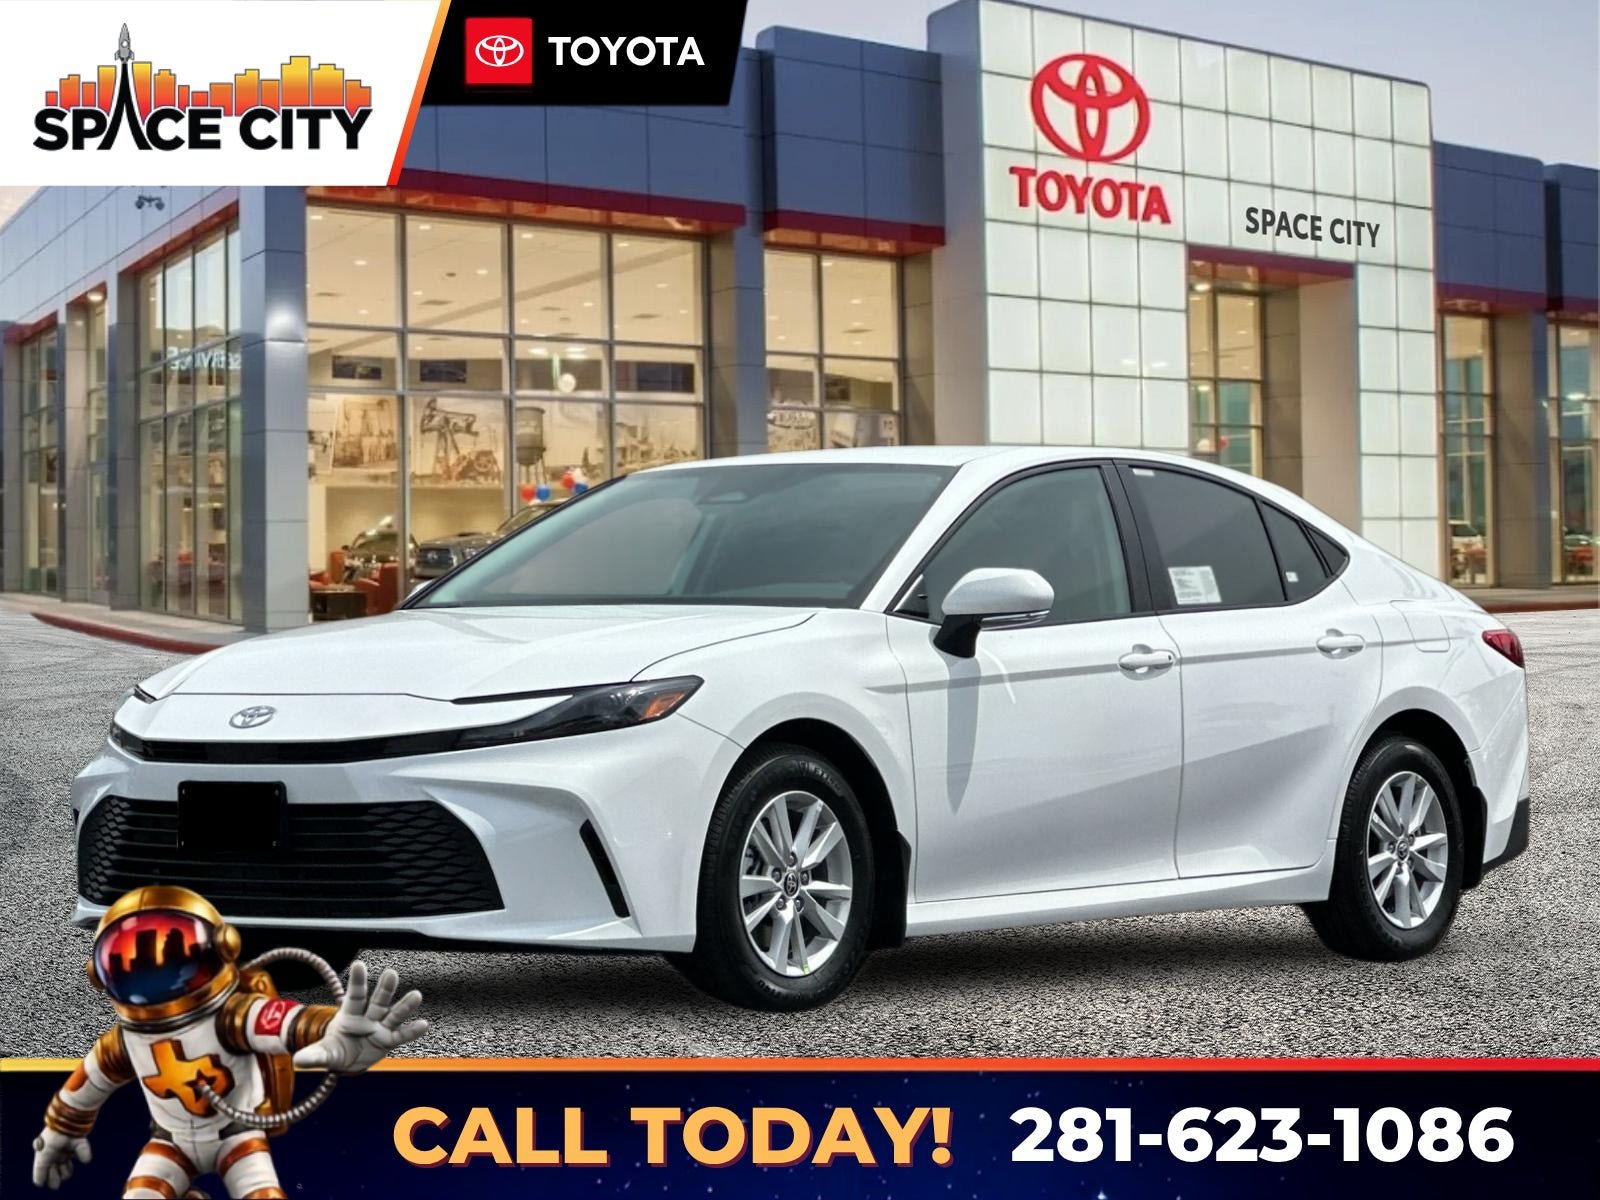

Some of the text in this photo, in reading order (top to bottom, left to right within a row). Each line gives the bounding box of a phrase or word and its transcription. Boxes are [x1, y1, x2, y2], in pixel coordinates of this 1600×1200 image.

[1008, 166, 1172, 225] TOYOTA
[1244, 206, 1381, 248] SPACE CITY
